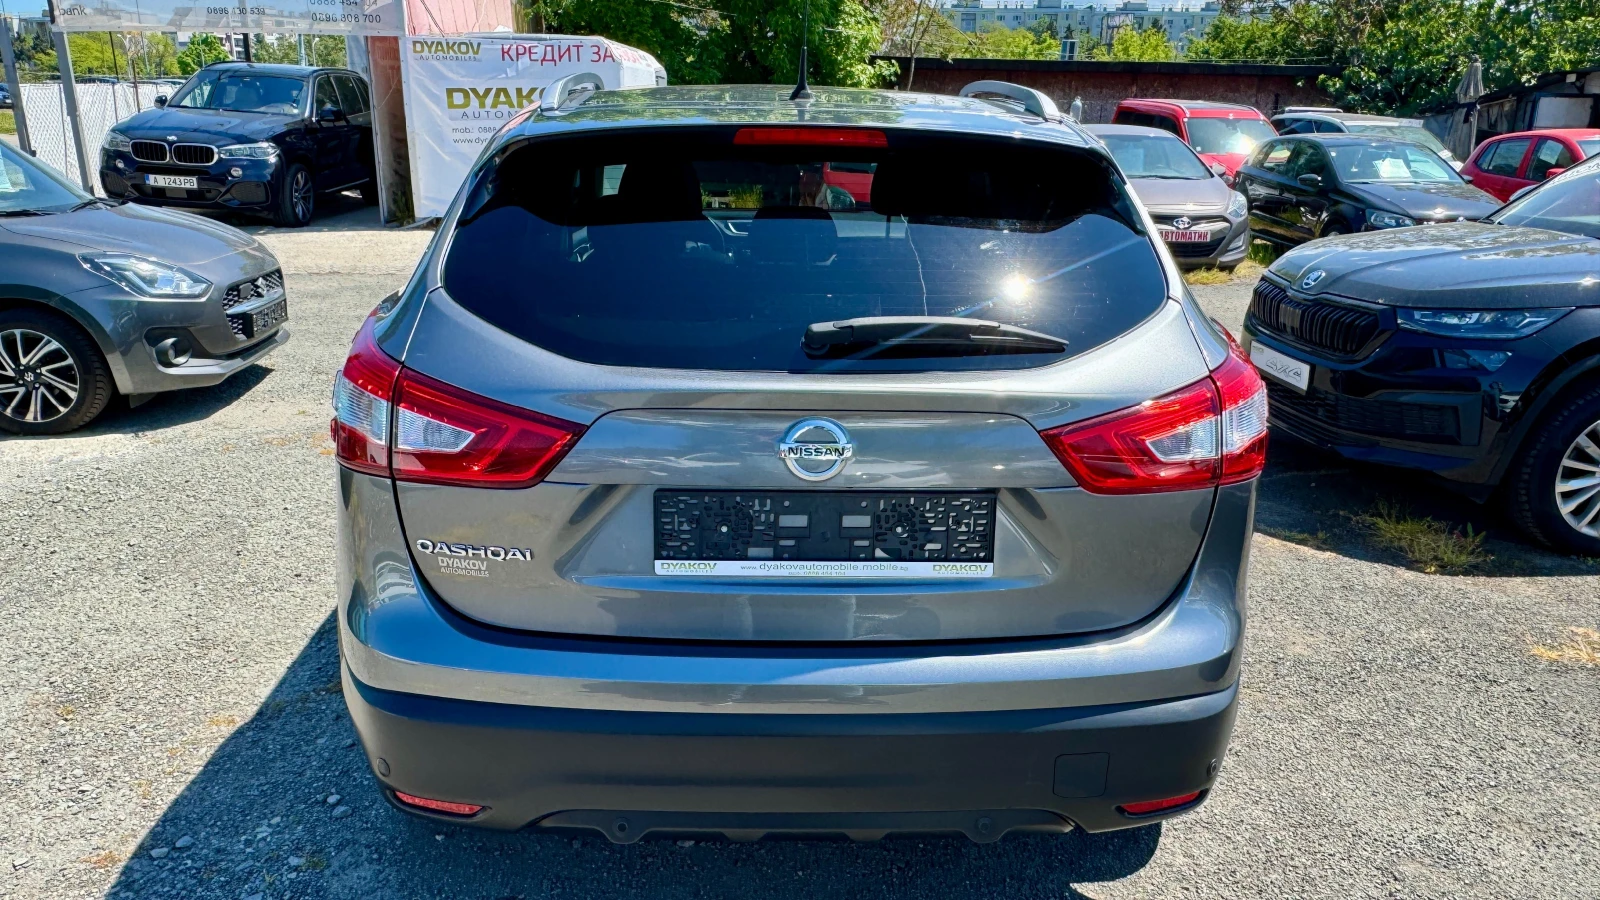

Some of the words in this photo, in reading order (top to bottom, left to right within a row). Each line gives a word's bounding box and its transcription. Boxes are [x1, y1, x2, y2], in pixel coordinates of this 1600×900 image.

[362, 14, 381, 23] 700
[412, 40, 482, 55] DYAKOV
[501, 44, 584, 66] КРЕДИТ
[590, 44, 615, 63] ЗА
[445, 87, 545, 109] DYAK
[153, 176, 159, 185] A
[787, 446, 845, 457] NISSAN
[416, 539, 532, 562] QASHQAI
[438, 556, 487, 571] DYAKOV
[660, 562, 718, 570] DYAKOV
[932, 564, 988, 572] DYAKOV
